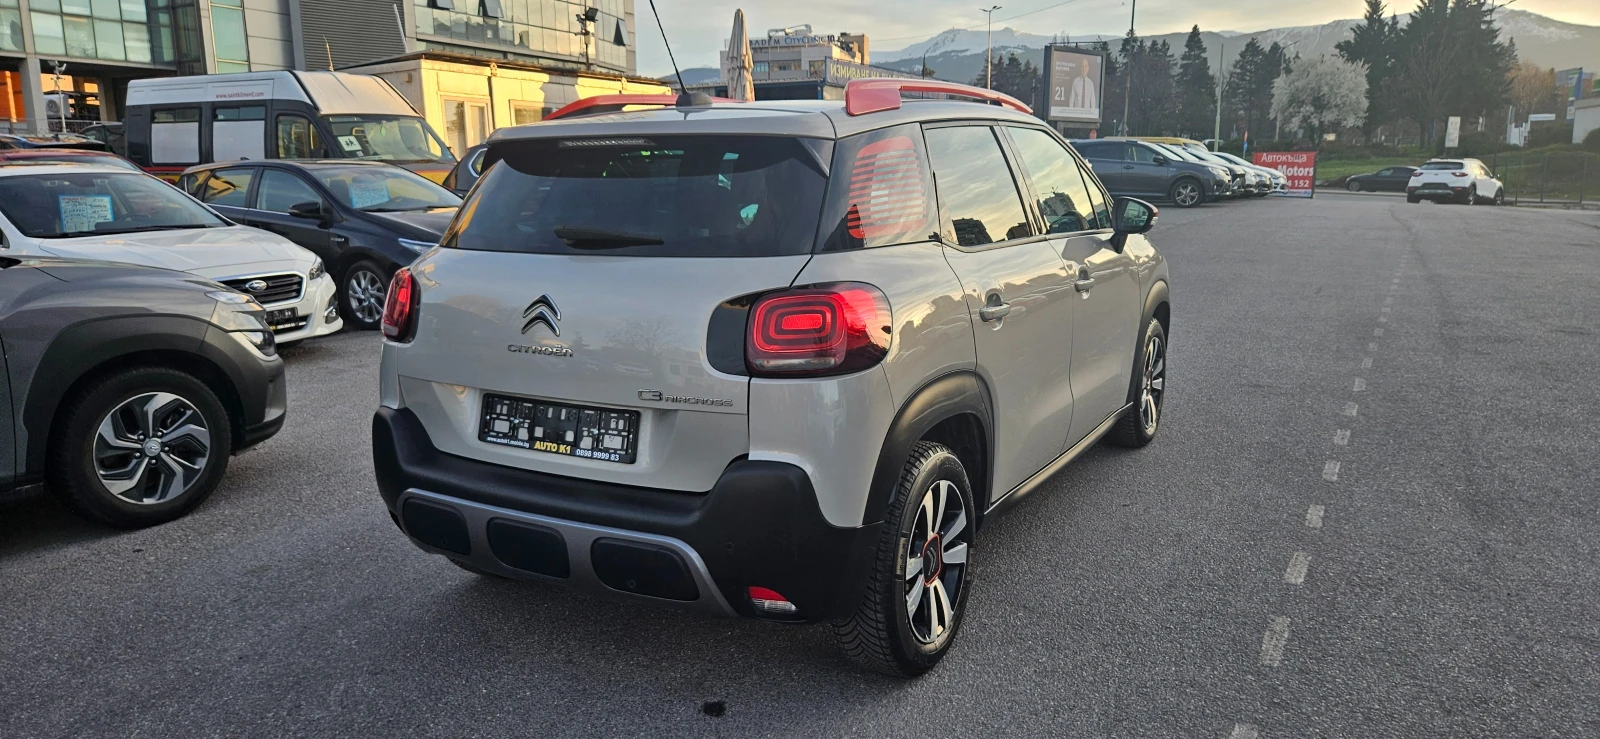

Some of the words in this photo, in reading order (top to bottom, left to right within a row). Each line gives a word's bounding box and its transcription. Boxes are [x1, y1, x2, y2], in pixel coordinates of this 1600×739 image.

[1054, 86, 1065, 101] 21
[1260, 152, 1307, 163] Автокъща
[1294, 180, 1309, 188] 152
[637, 388, 663, 401] C3
[664, 394, 733, 407] AIRCROSS
[534, 440, 558, 452] AUTO
[559, 445, 571, 454] K1
[576, 448, 592, 457] 0898
[593, 450, 609, 460] 9999
[610, 453, 620, 461] 83
